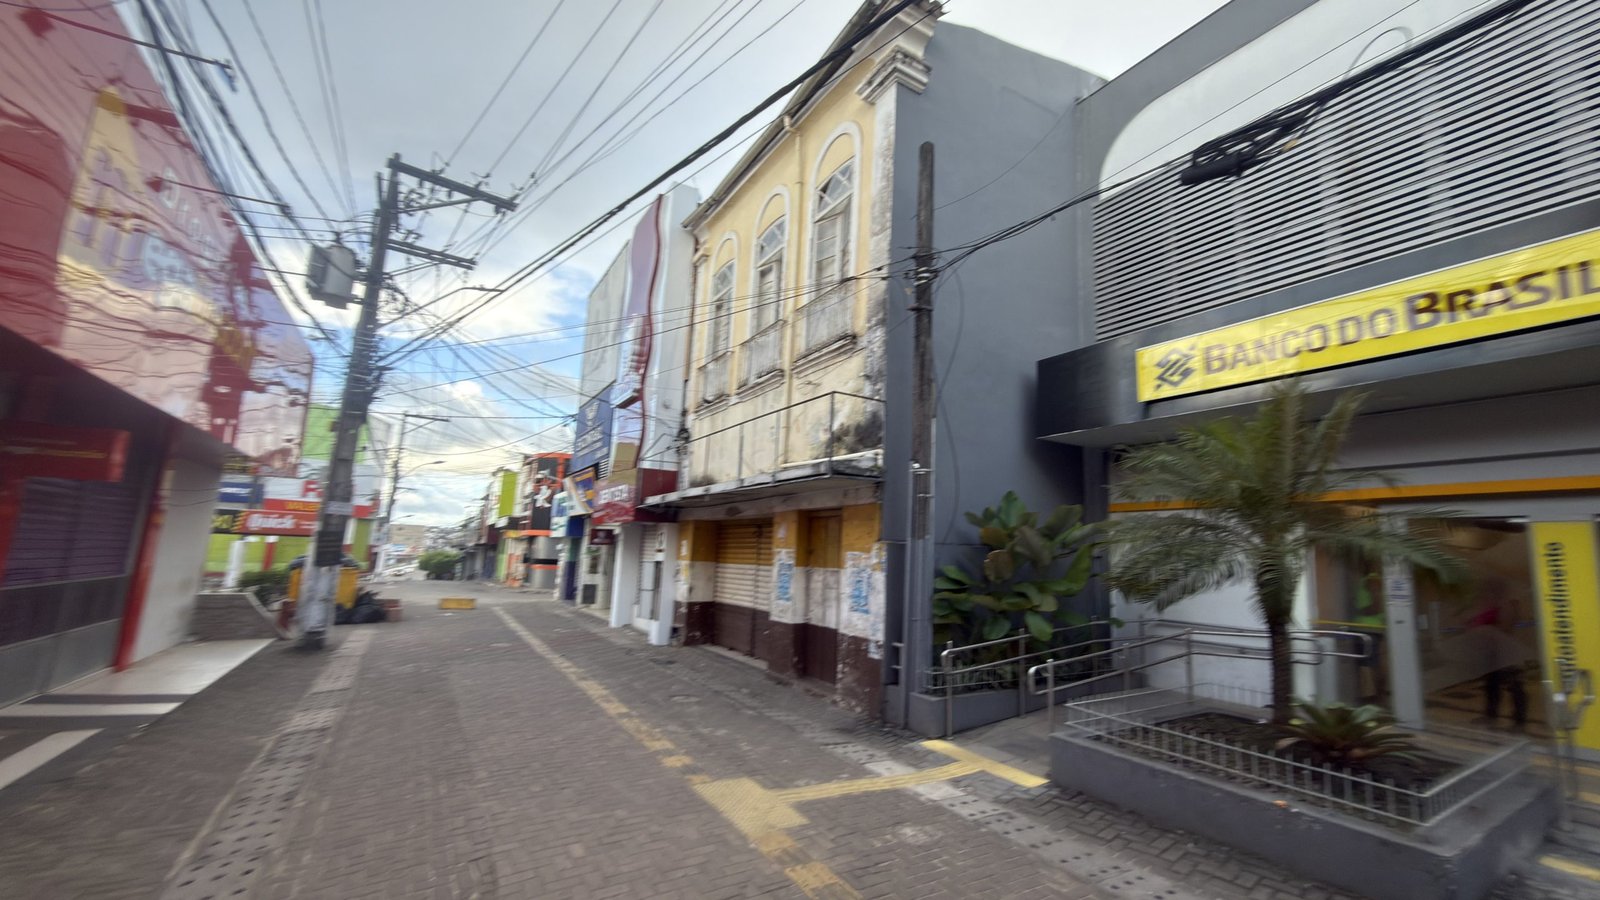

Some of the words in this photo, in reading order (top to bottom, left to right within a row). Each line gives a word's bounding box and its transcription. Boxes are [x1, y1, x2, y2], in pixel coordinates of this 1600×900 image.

[1204, 323, 1330, 374] BANCO
[1336, 306, 1396, 347] DO
[1402, 259, 1600, 332] BRASIL
